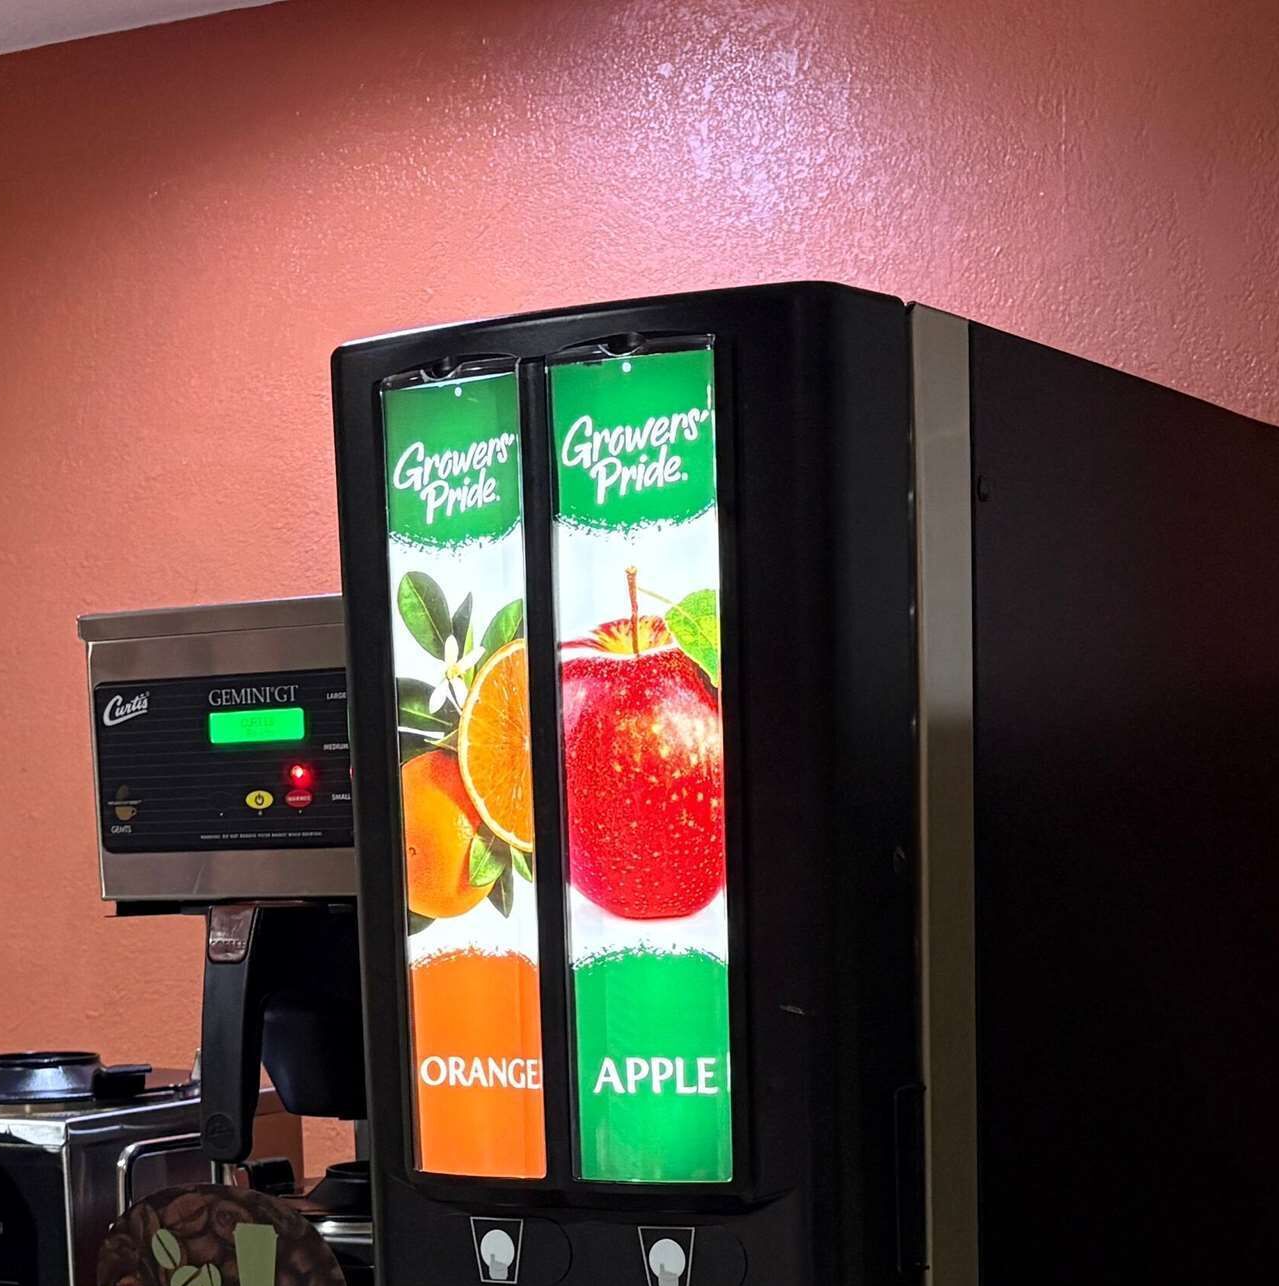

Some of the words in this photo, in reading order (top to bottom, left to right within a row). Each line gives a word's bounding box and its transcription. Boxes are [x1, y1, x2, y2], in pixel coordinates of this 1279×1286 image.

[103, 692, 149, 727] Curtis
[420, 1056, 542, 1090] ORANGE
[593, 1056, 719, 1096] APPLE
